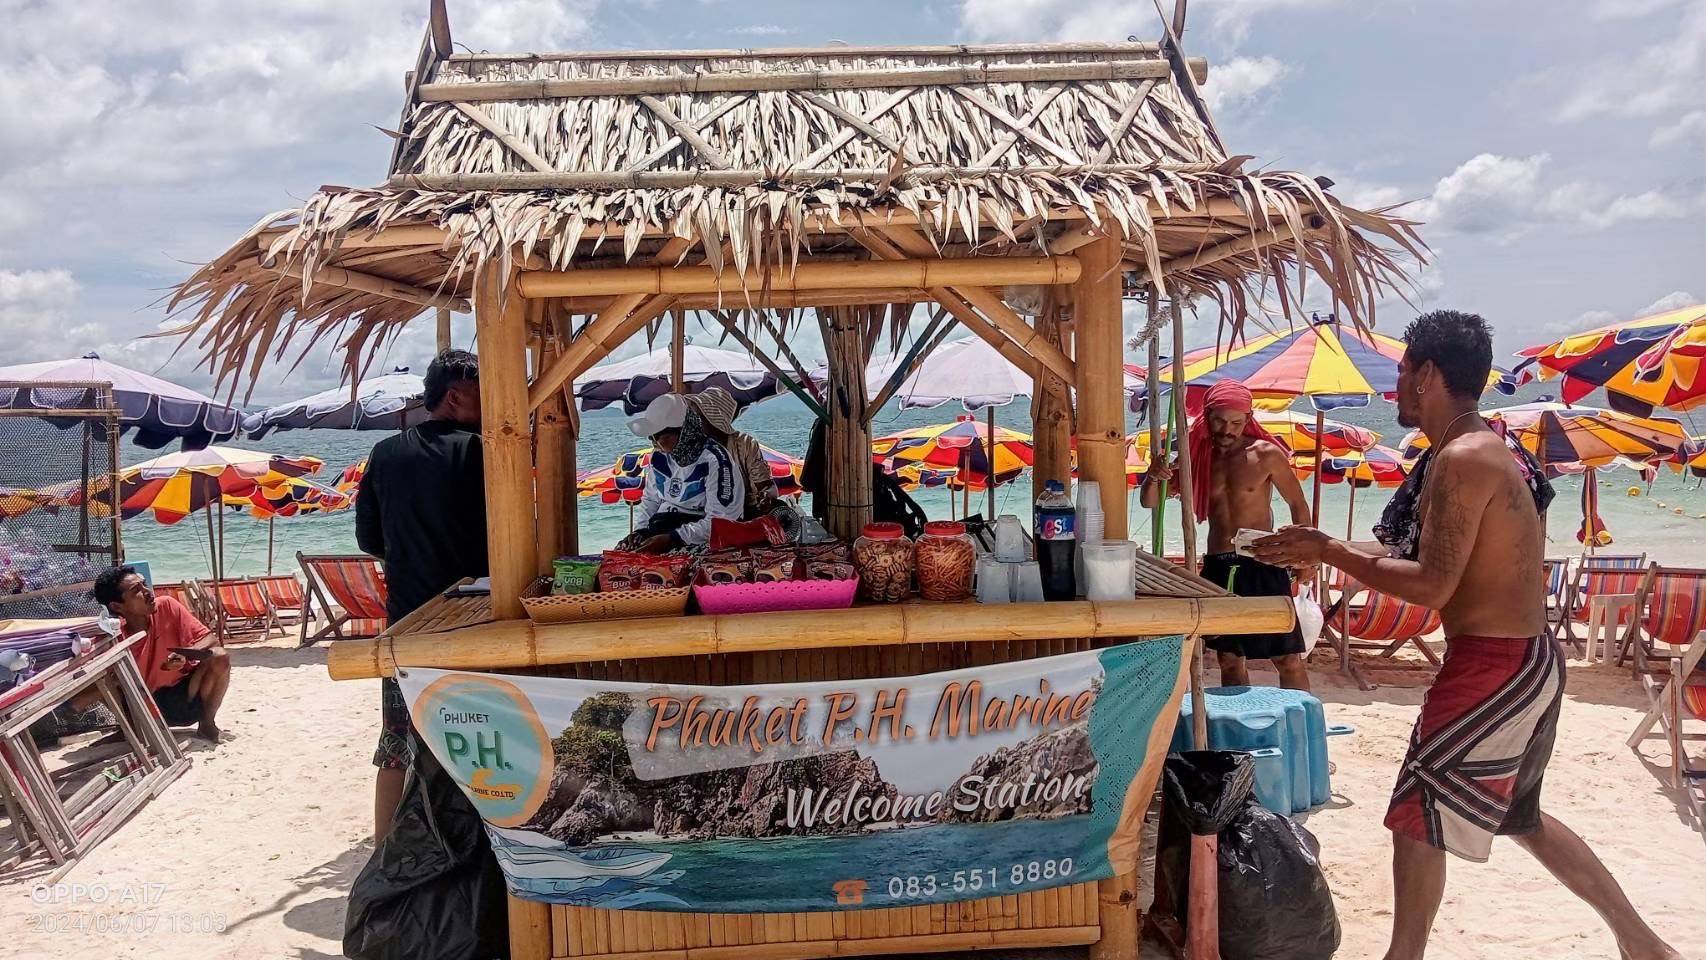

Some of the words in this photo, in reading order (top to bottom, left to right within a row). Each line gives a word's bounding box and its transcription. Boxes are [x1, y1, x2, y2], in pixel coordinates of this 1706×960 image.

[444, 712, 490, 724] PHUKET
[646, 695, 807, 753] Phuket
[823, 687, 914, 746] P.H.
[929, 678, 1094, 738] Marine
[444, 730, 513, 770] P.H.
[786, 780, 943, 829] Welcome
[952, 771, 1087, 812] Station
[1010, 857, 1073, 886] 8880
